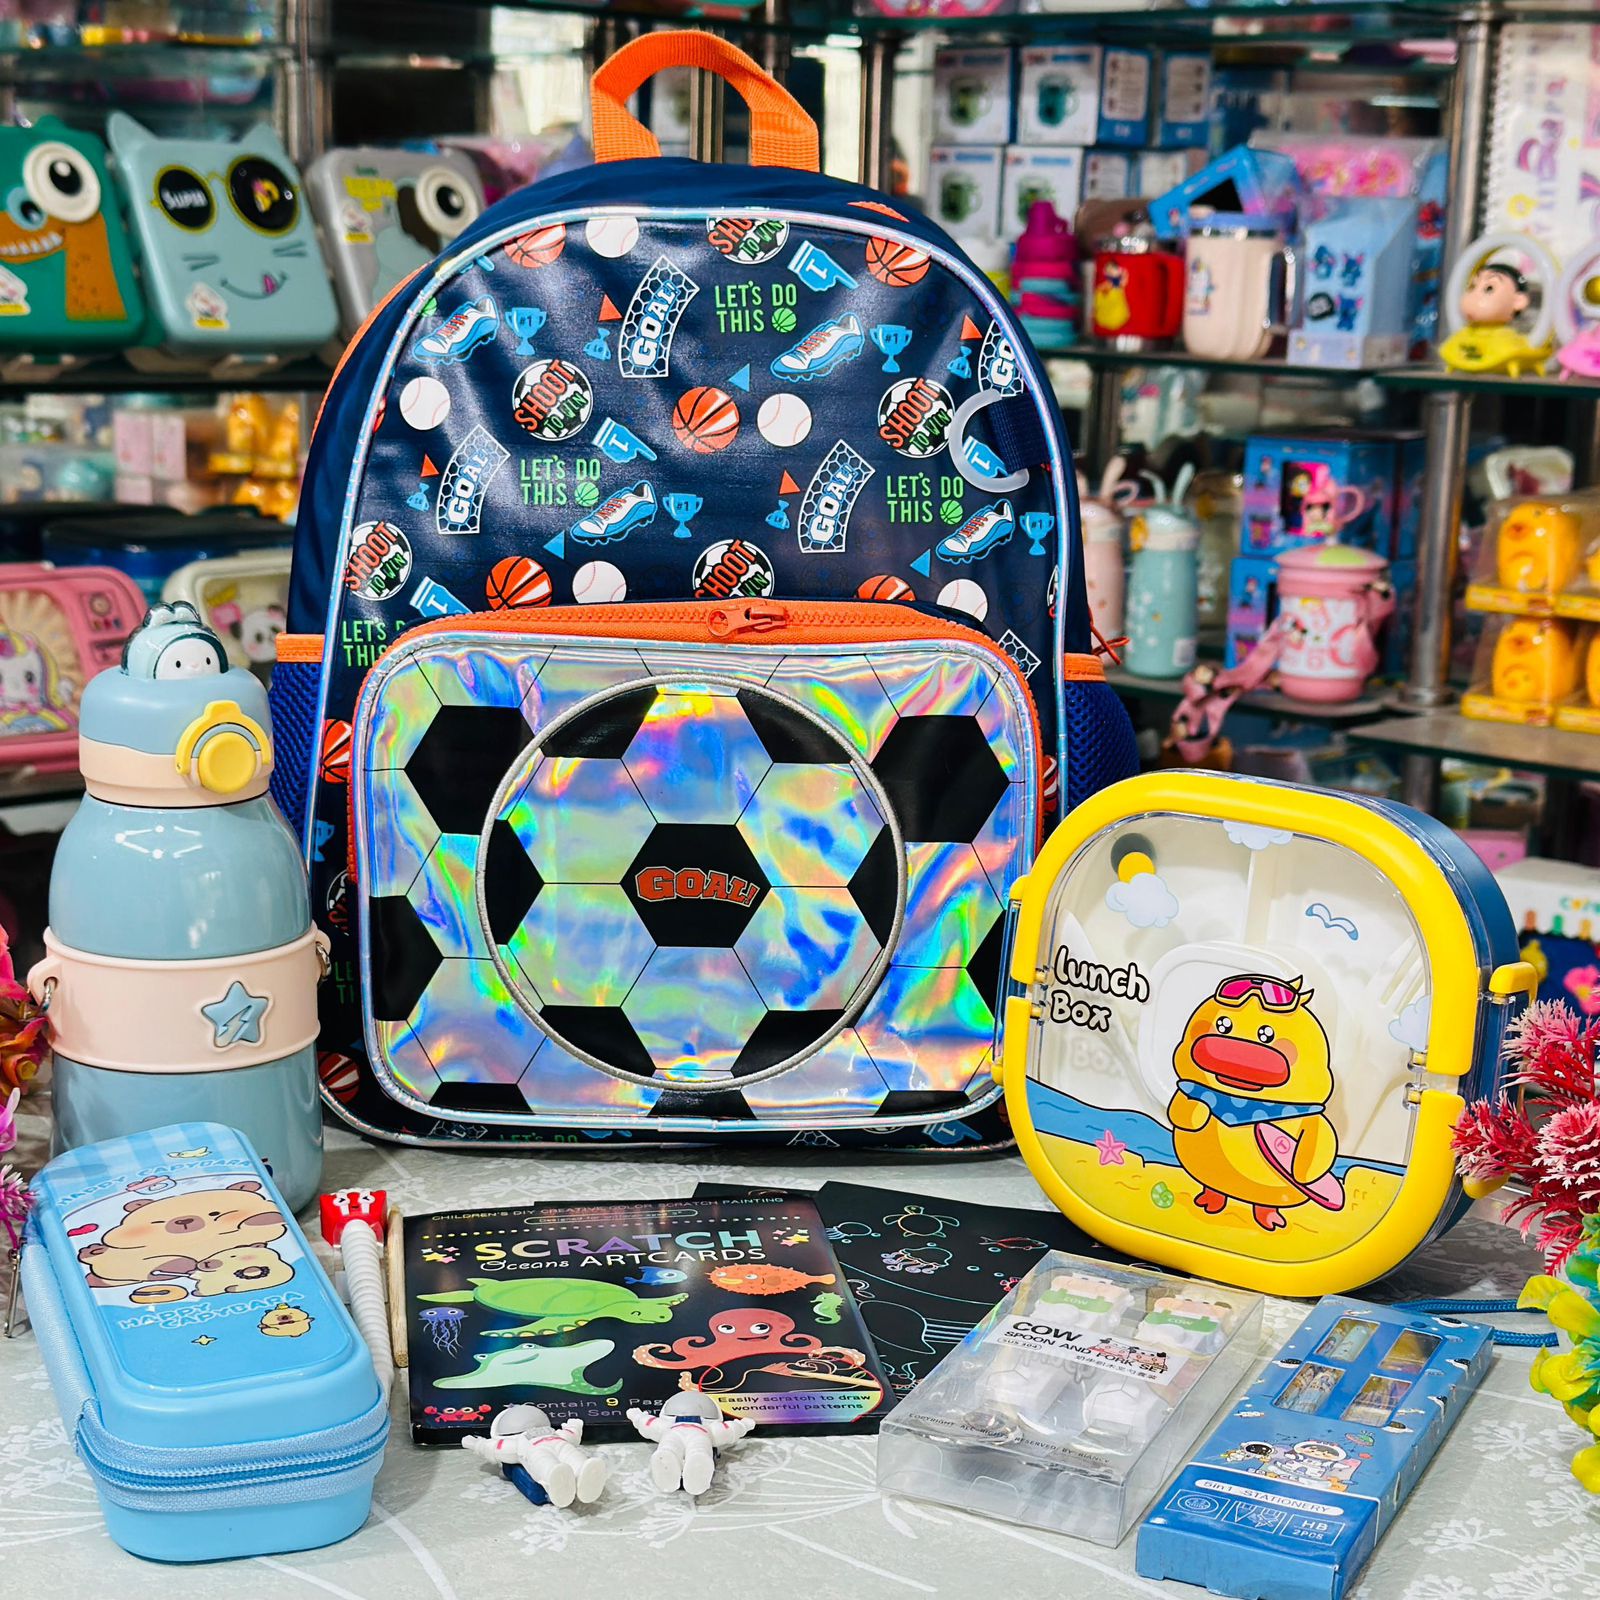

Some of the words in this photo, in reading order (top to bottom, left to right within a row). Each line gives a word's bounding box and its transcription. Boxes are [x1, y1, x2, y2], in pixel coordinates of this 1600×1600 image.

[739, 237, 760, 258] TO
[714, 281, 763, 307] LET'S
[771, 283, 798, 305] DO
[716, 309, 766, 333] THIS
[513, 359, 578, 431] SHOOT
[542, 413, 565, 438] TO
[557, 390, 589, 419] WIN
[879, 378, 941, 448] SHOOT
[909, 429, 931, 452] TO
[924, 410, 951, 436] WIN
[519, 455, 567, 481] LET'S
[576, 458, 602, 479] DO
[521, 482, 568, 505] THIS
[886, 472, 932, 498] LET'S
[940, 476, 965, 498] DO
[888, 501, 933, 523] THIS
[366, 575, 387, 597] TO
[381, 552, 408, 579] WIN
[341, 616, 388, 643] LET'S
[635, 866, 760, 907] GOAL!
[1050, 989, 1112, 1032] Box
[56, 1174, 127, 1207] HAPPY
[135, 1158, 253, 1177] CAPYBARA
[432, 1211, 510, 1221] CHILDREN'S
[513, 1208, 536, 1216] DIY
[659, 1200, 719, 1208] SCRATCH
[722, 1197, 784, 1205] PAINTING
[474, 1229, 763, 1262] SCRATCH
[480, 1259, 570, 1271] Oceans
[580, 1248, 766, 1267] ARTCARDS
[118, 1302, 211, 1330] HAPPY
[159, 1290, 305, 1330] CAPYBARA
[1012, 1321, 1083, 1342] COW
[1004, 1331, 1056, 1346] SPOON
[1058, 1343, 1092, 1355] AND
[1096, 1352, 1137, 1367] FORK
[606, 1397, 619, 1407] 9
[629, 1398, 664, 1407] Pag
[718, 1396, 759, 1404] Easily
[731, 1403, 800, 1411] wonderful
[804, 1402, 864, 1411] patterns
[1203, 1480, 1233, 1492] 5in1
[1243, 1488, 1332, 1514] STATIONERY
[1292, 1528, 1325, 1541] 2PCS
[1301, 1519, 1329, 1532] HB
